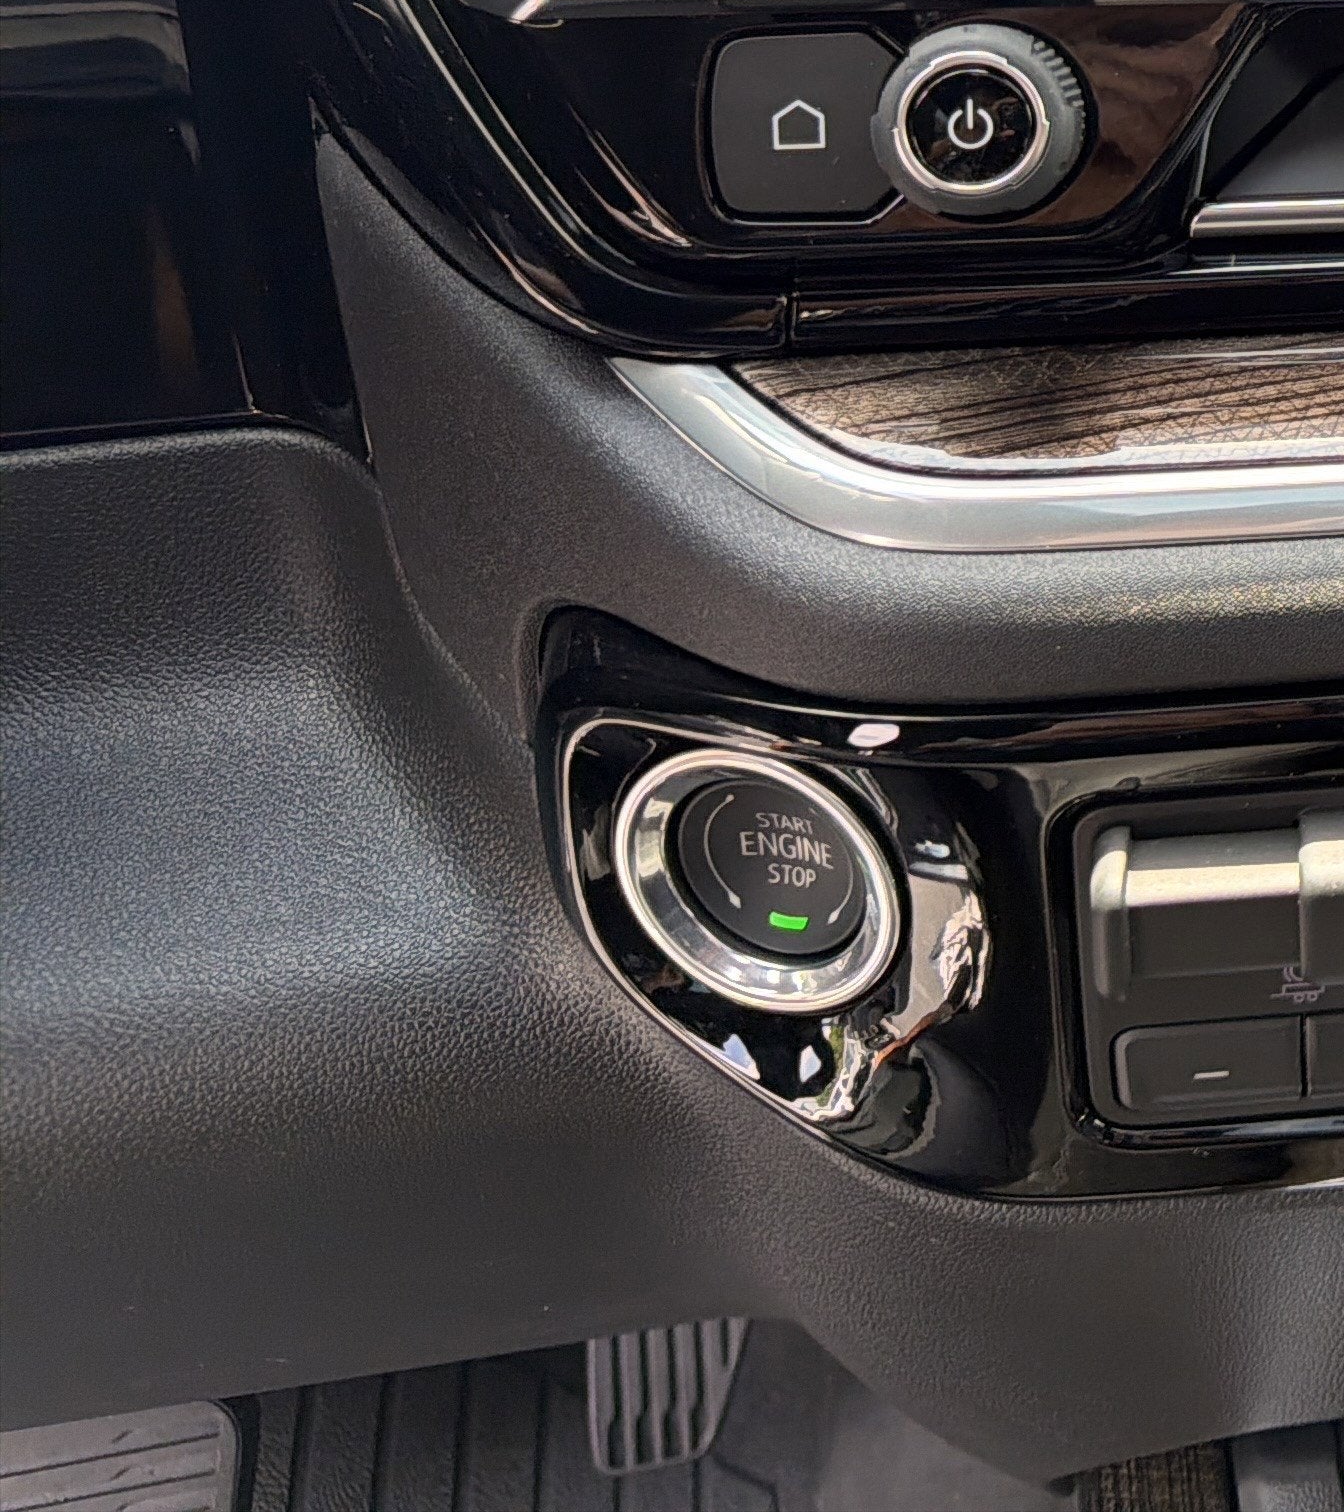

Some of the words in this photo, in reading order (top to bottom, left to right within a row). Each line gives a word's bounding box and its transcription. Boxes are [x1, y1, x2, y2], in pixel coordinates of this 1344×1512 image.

[755, 812, 813, 835] START
[739, 830, 834, 870] ENGINE
[767, 862, 817, 888] STOP
